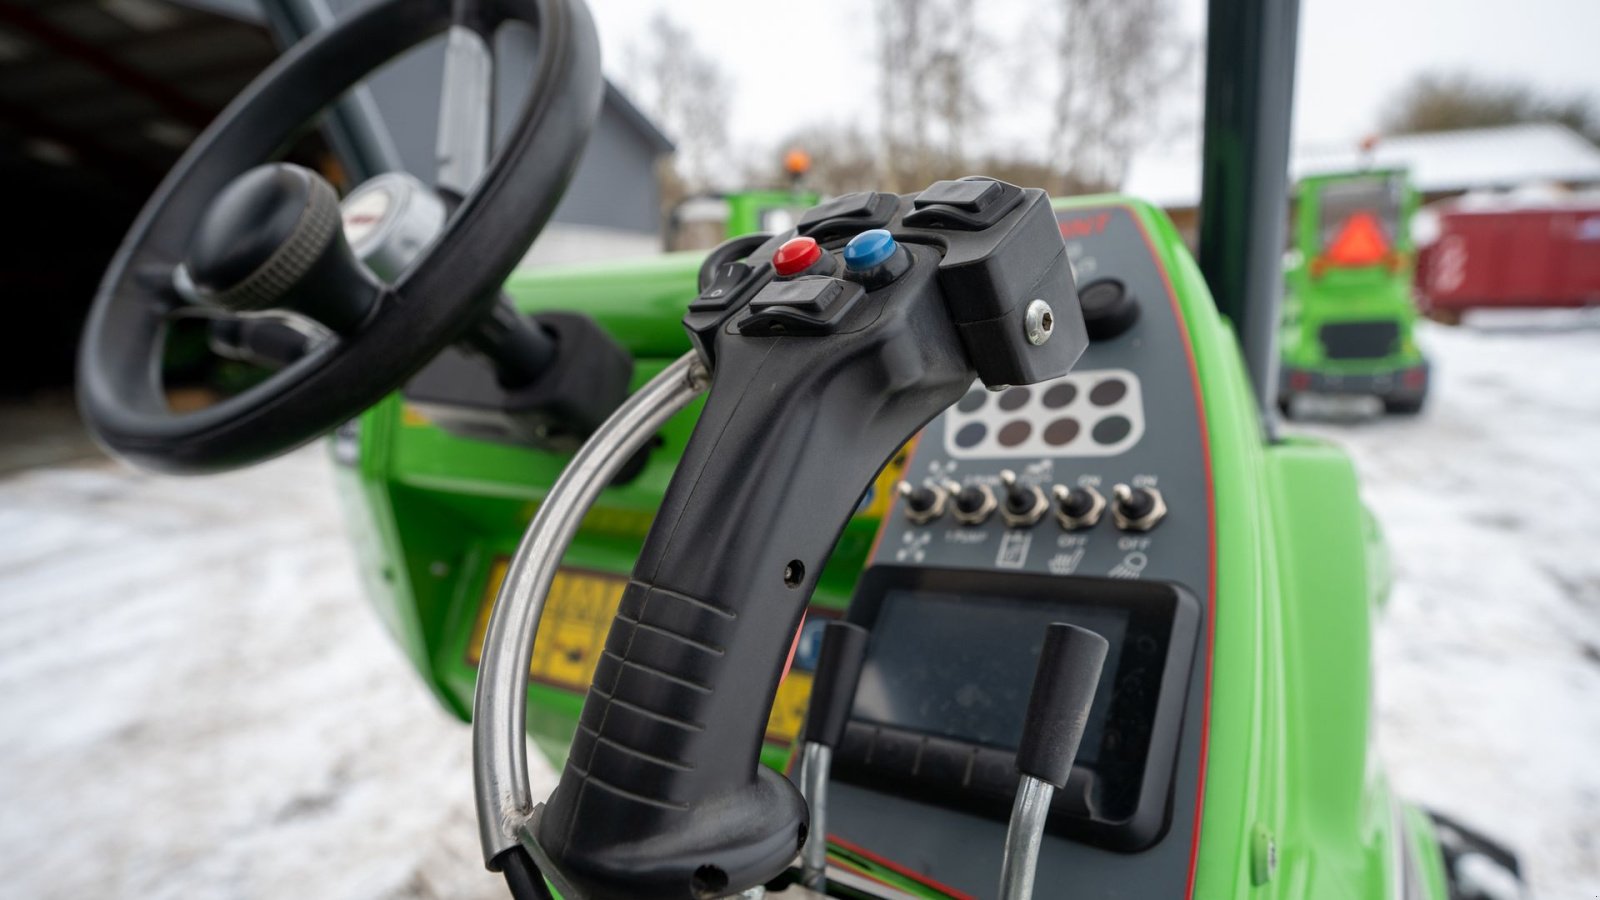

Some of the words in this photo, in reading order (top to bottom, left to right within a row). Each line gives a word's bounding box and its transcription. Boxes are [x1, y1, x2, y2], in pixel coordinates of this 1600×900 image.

[1078, 474, 1102, 487] ON
[1132, 474, 1158, 488] ON
[1057, 534, 1088, 548] OFF
[1118, 536, 1152, 550] OFF
